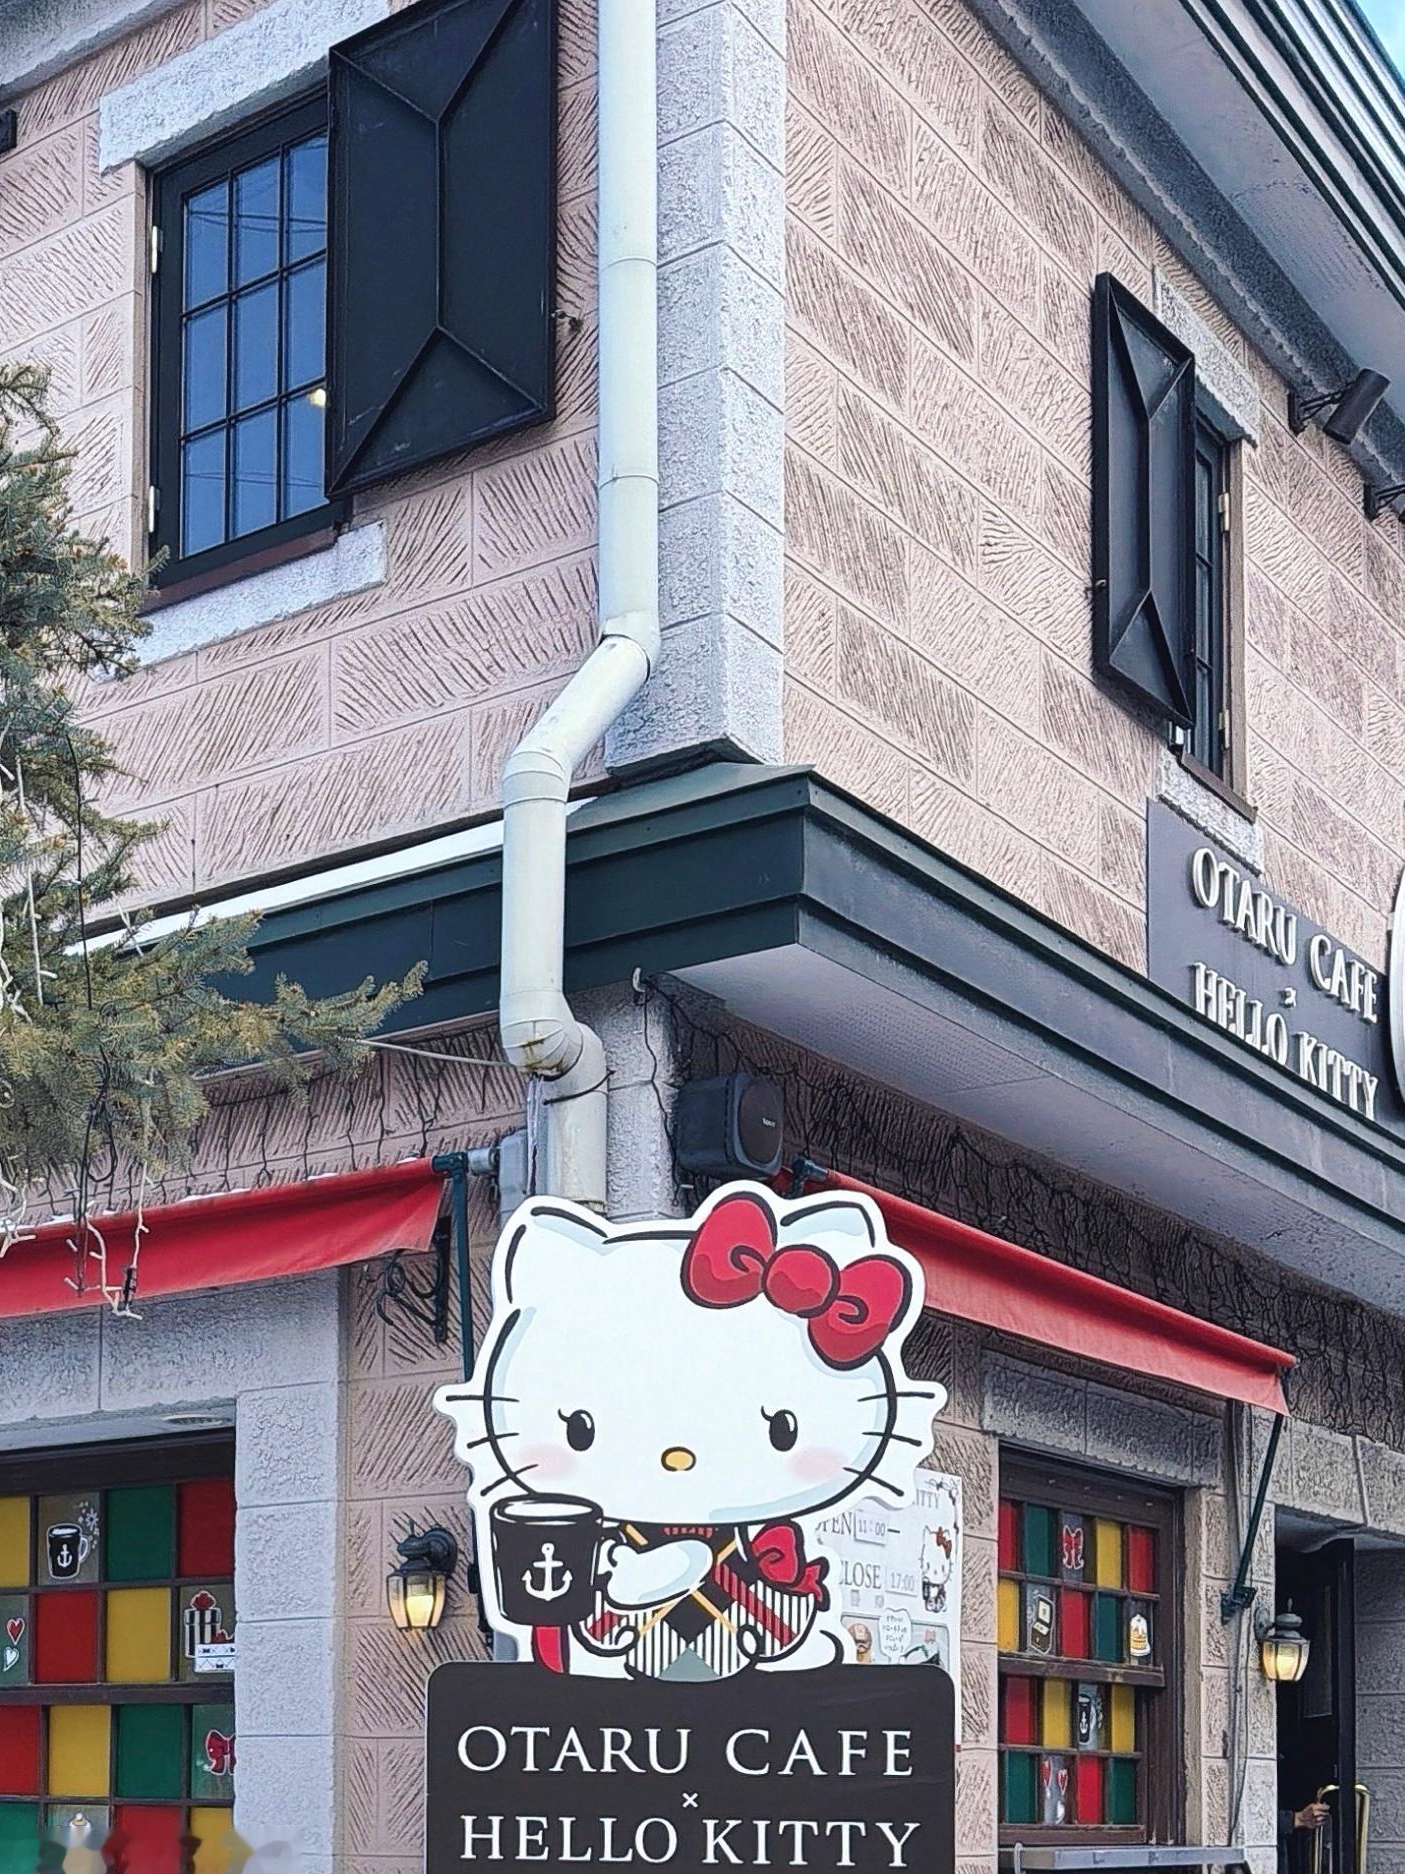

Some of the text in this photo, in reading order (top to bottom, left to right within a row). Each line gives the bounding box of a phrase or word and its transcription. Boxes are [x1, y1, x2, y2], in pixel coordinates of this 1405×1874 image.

[1192, 847, 1378, 1024] OTARU CAFE
[1193, 962, 1379, 1121] HELLO KITTY
[912, 1488, 940, 1509] ITTY
[839, 1560, 882, 1590] LOSE
[457, 1725, 913, 1776] OTARU CAFE
[460, 1814, 921, 1867] HELLO KITTY
